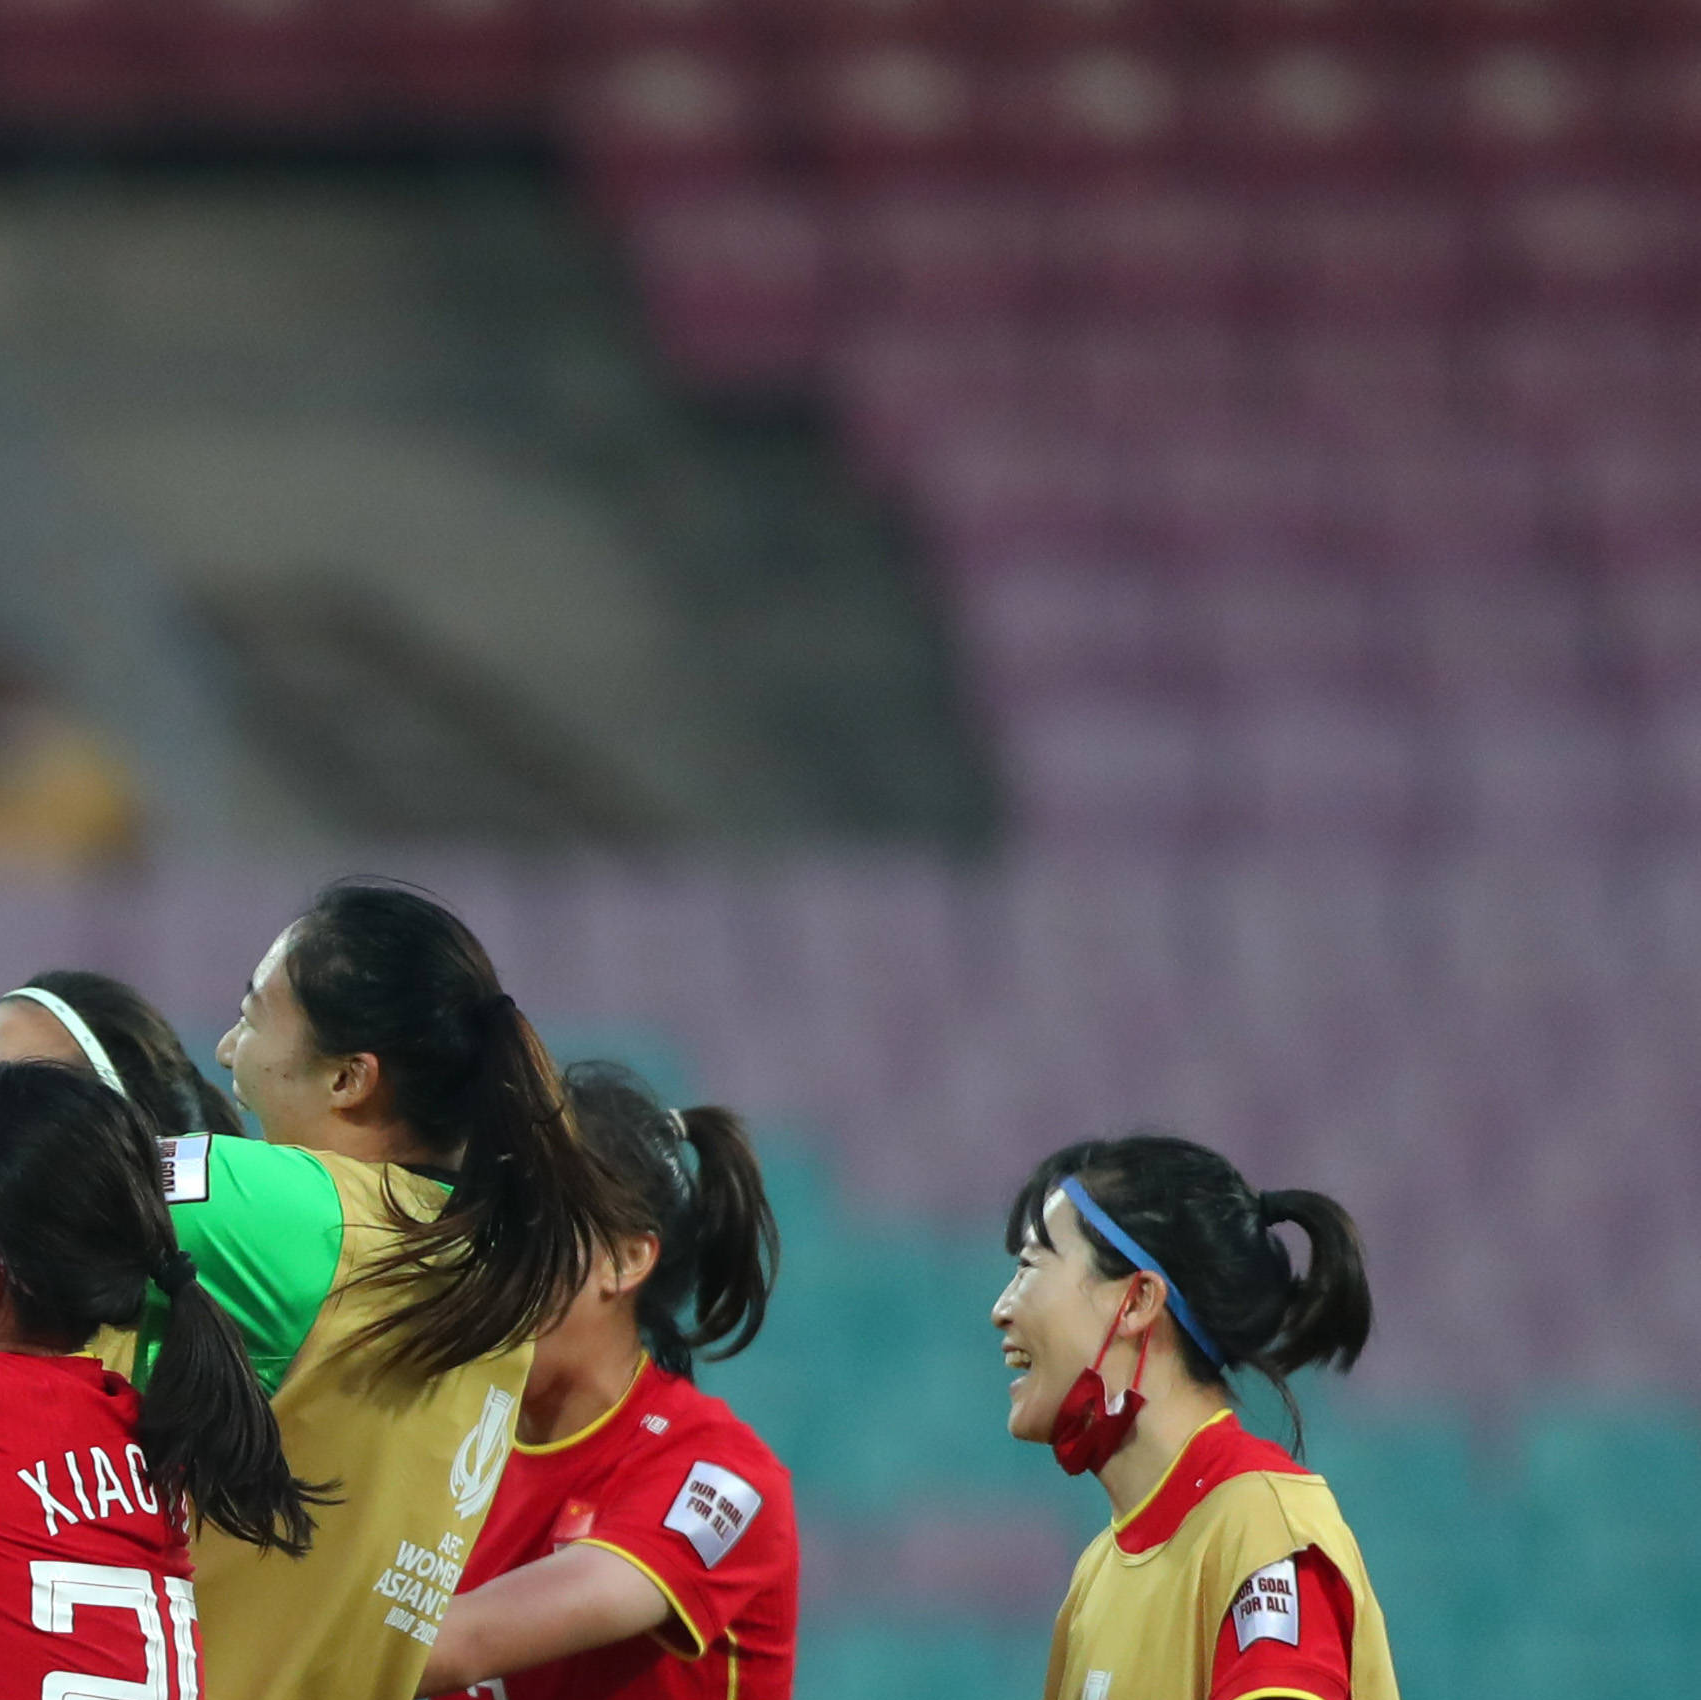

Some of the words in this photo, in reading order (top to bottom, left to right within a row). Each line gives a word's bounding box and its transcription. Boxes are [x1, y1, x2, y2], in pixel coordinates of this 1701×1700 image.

[372, 1567, 441, 1616] ASIAN
[1257, 1576, 1294, 1597] GOAL
[1240, 1596, 1263, 1620] FOR
[1266, 1595, 1290, 1616] ALL
